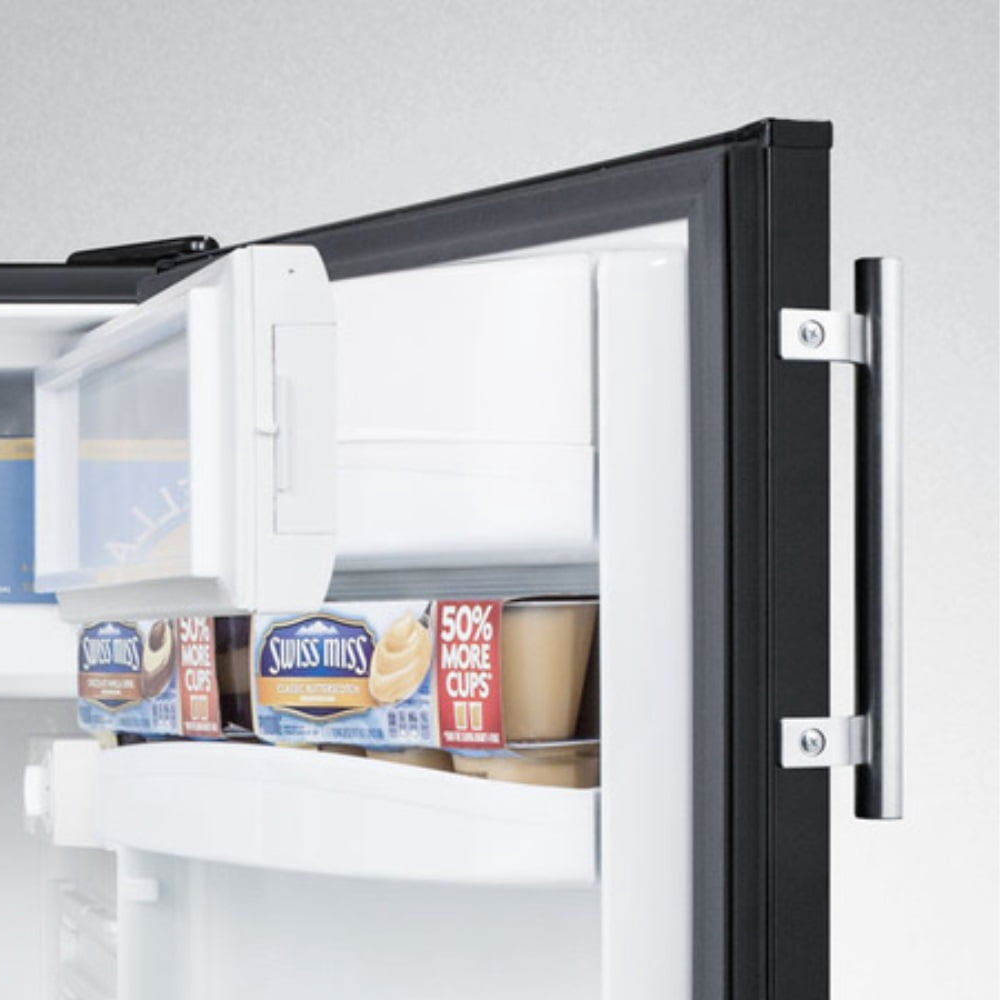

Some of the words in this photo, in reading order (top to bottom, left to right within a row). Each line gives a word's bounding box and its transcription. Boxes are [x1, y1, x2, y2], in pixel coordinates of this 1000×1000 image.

[441, 605, 493, 641] 50%
[181, 645, 211, 667] MORE
[268, 636, 321, 675] SWISS
[441, 643, 491, 669] MORE
